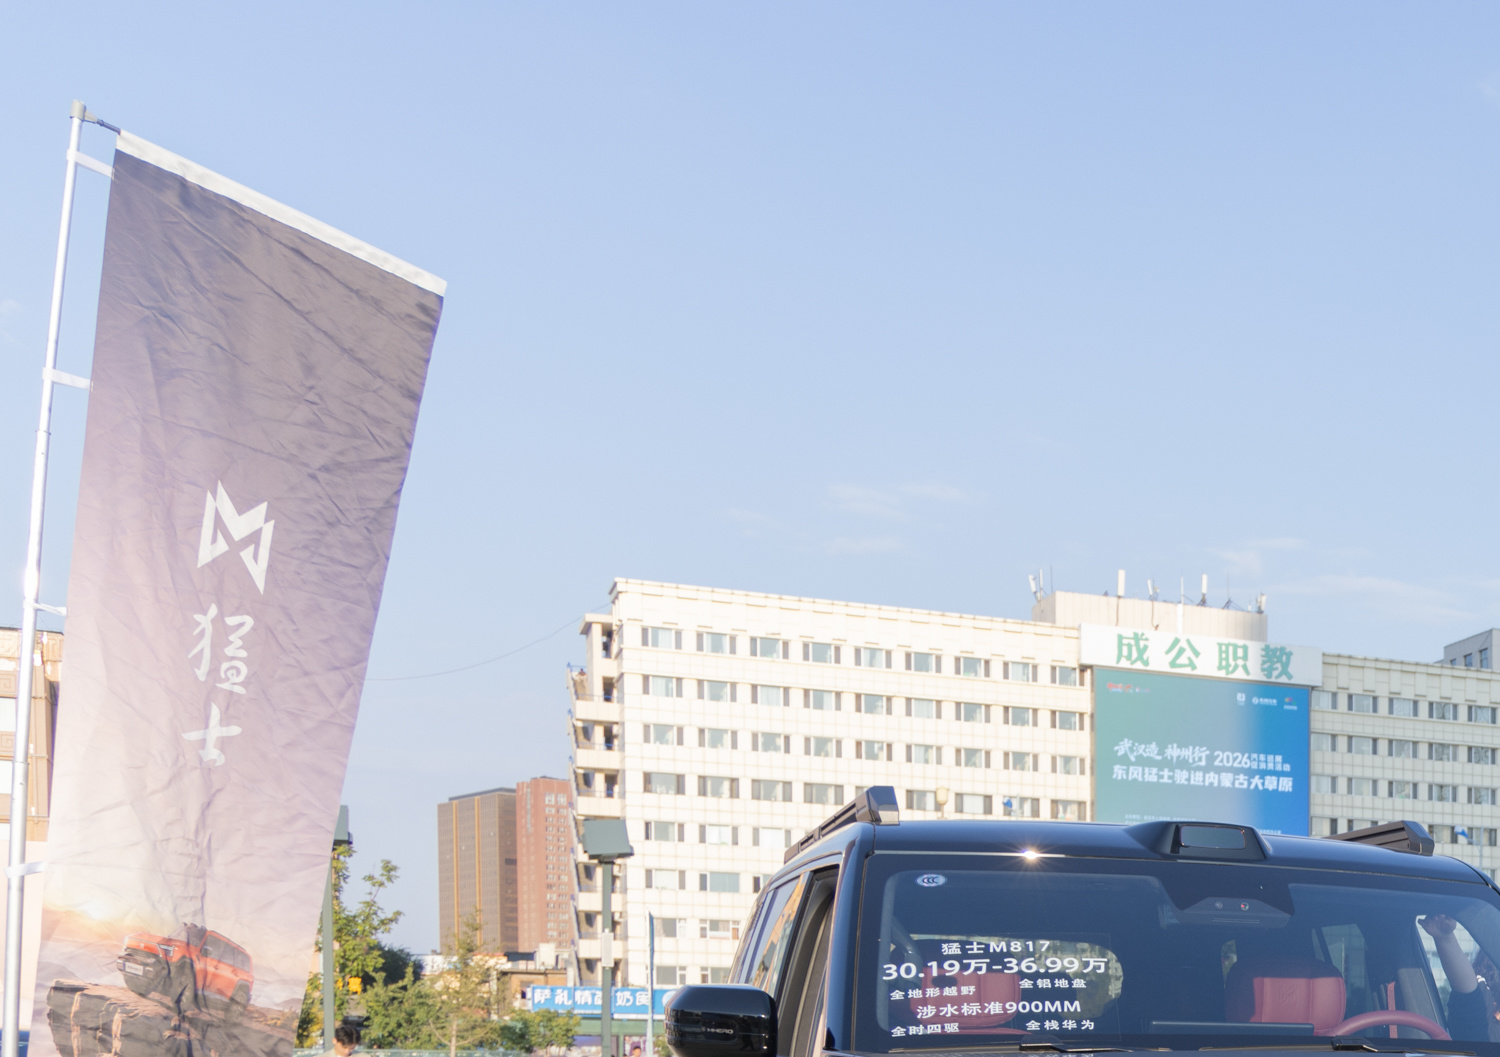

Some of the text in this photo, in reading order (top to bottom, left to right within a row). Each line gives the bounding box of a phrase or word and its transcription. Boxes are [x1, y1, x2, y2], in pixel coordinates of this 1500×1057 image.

[1115, 632, 1294, 681] 成公职教
[181, 602, 255, 767] 猛士
[1114, 738, 1251, 769] 武汉造 神州行 2026
[1112, 764, 1294, 793] 东风猛士驶进内蒙古大草原
[941, 940, 1051, 955] 猛士M817
[882, 957, 1108, 980] 30.19万-36.99万
[890, 985, 977, 1001] 全地形越野
[1018, 978, 1088, 989] 全铝地盘
[916, 1000, 1082, 1019] 涉水标准900MM
[890, 1023, 960, 1037] 全时四驱
[1026, 1020, 1096, 1031] 全栈华为
